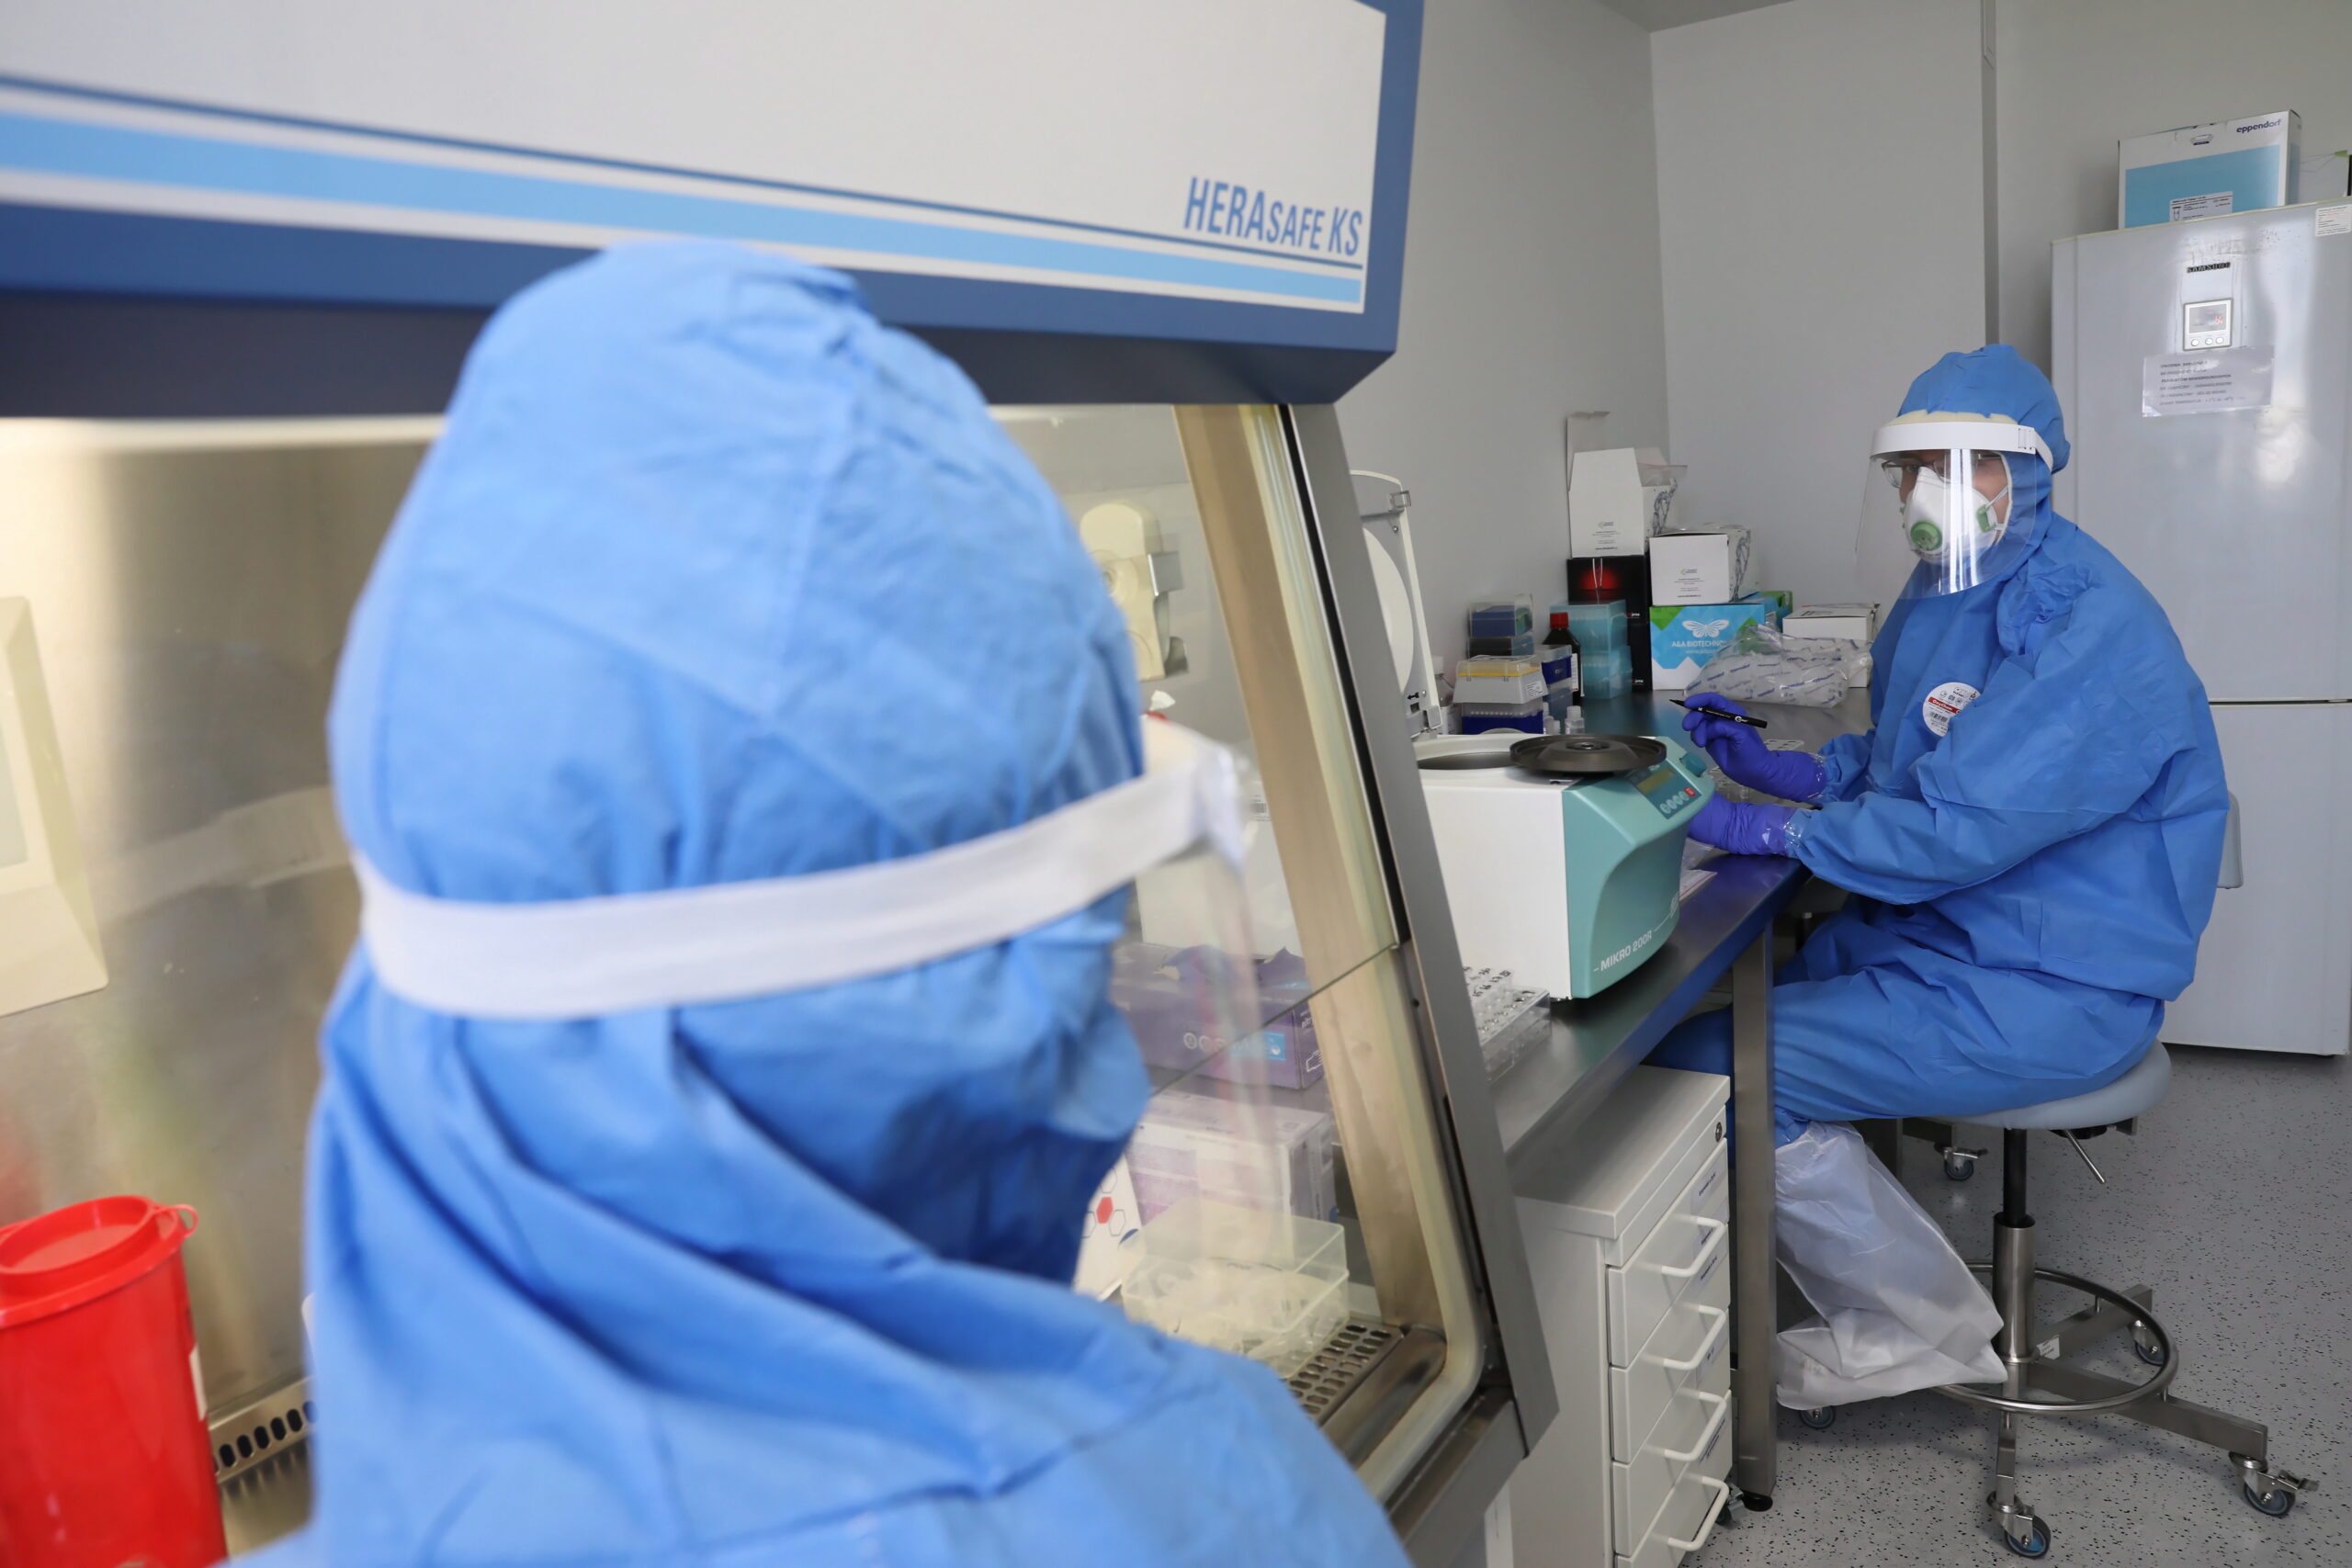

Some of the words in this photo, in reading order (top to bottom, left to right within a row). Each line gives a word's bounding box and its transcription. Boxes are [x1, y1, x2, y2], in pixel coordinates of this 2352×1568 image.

[2235, 119, 2281, 133] eppendorf
[1183, 175, 1326, 251] HERASAFE
[1328, 206, 1363, 256] KS
[1600, 944, 1631, 971] MIKRO
[1632, 930, 1653, 953] 200R
